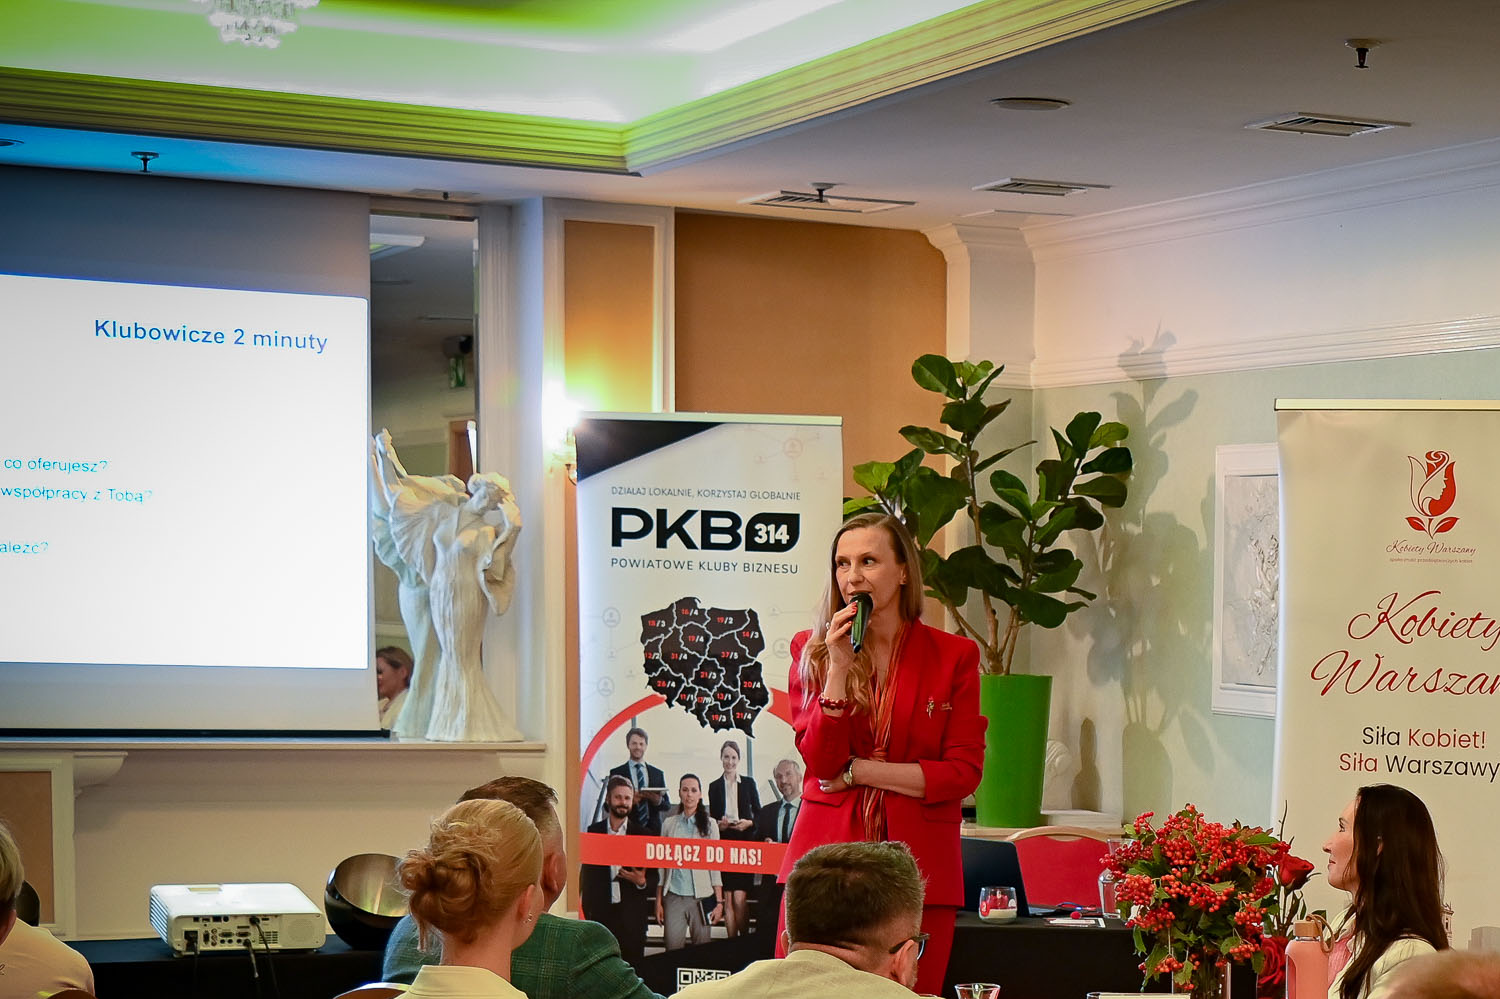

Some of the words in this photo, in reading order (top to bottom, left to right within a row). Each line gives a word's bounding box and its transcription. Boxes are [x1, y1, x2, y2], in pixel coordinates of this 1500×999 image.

[95, 319, 225, 344] Klubowicze
[233, 328, 245, 345] 2
[253, 330, 328, 354] minuty
[4, 459, 22, 469] co
[27, 457, 108, 475] oferujesz?
[697, 488, 747, 499] KORZYSTAJ
[749, 491, 801, 501] GLOBALNIE
[611, 506, 743, 551] PKB
[754, 523, 790, 545] 314
[1386, 539, 1425, 555] Kobiety
[611, 557, 694, 571] POWIATOWE
[699, 560, 739, 572] KLUBY
[743, 562, 799, 574] BIZNESU
[1362, 725, 1401, 746] Siła
[1407, 728, 1487, 749] Kobiet!
[1338, 752, 1378, 772] Siła
[646, 842, 700, 866] DOŁĄCZ
[706, 847, 724, 864] DO
[730, 847, 762, 866] NAS!
